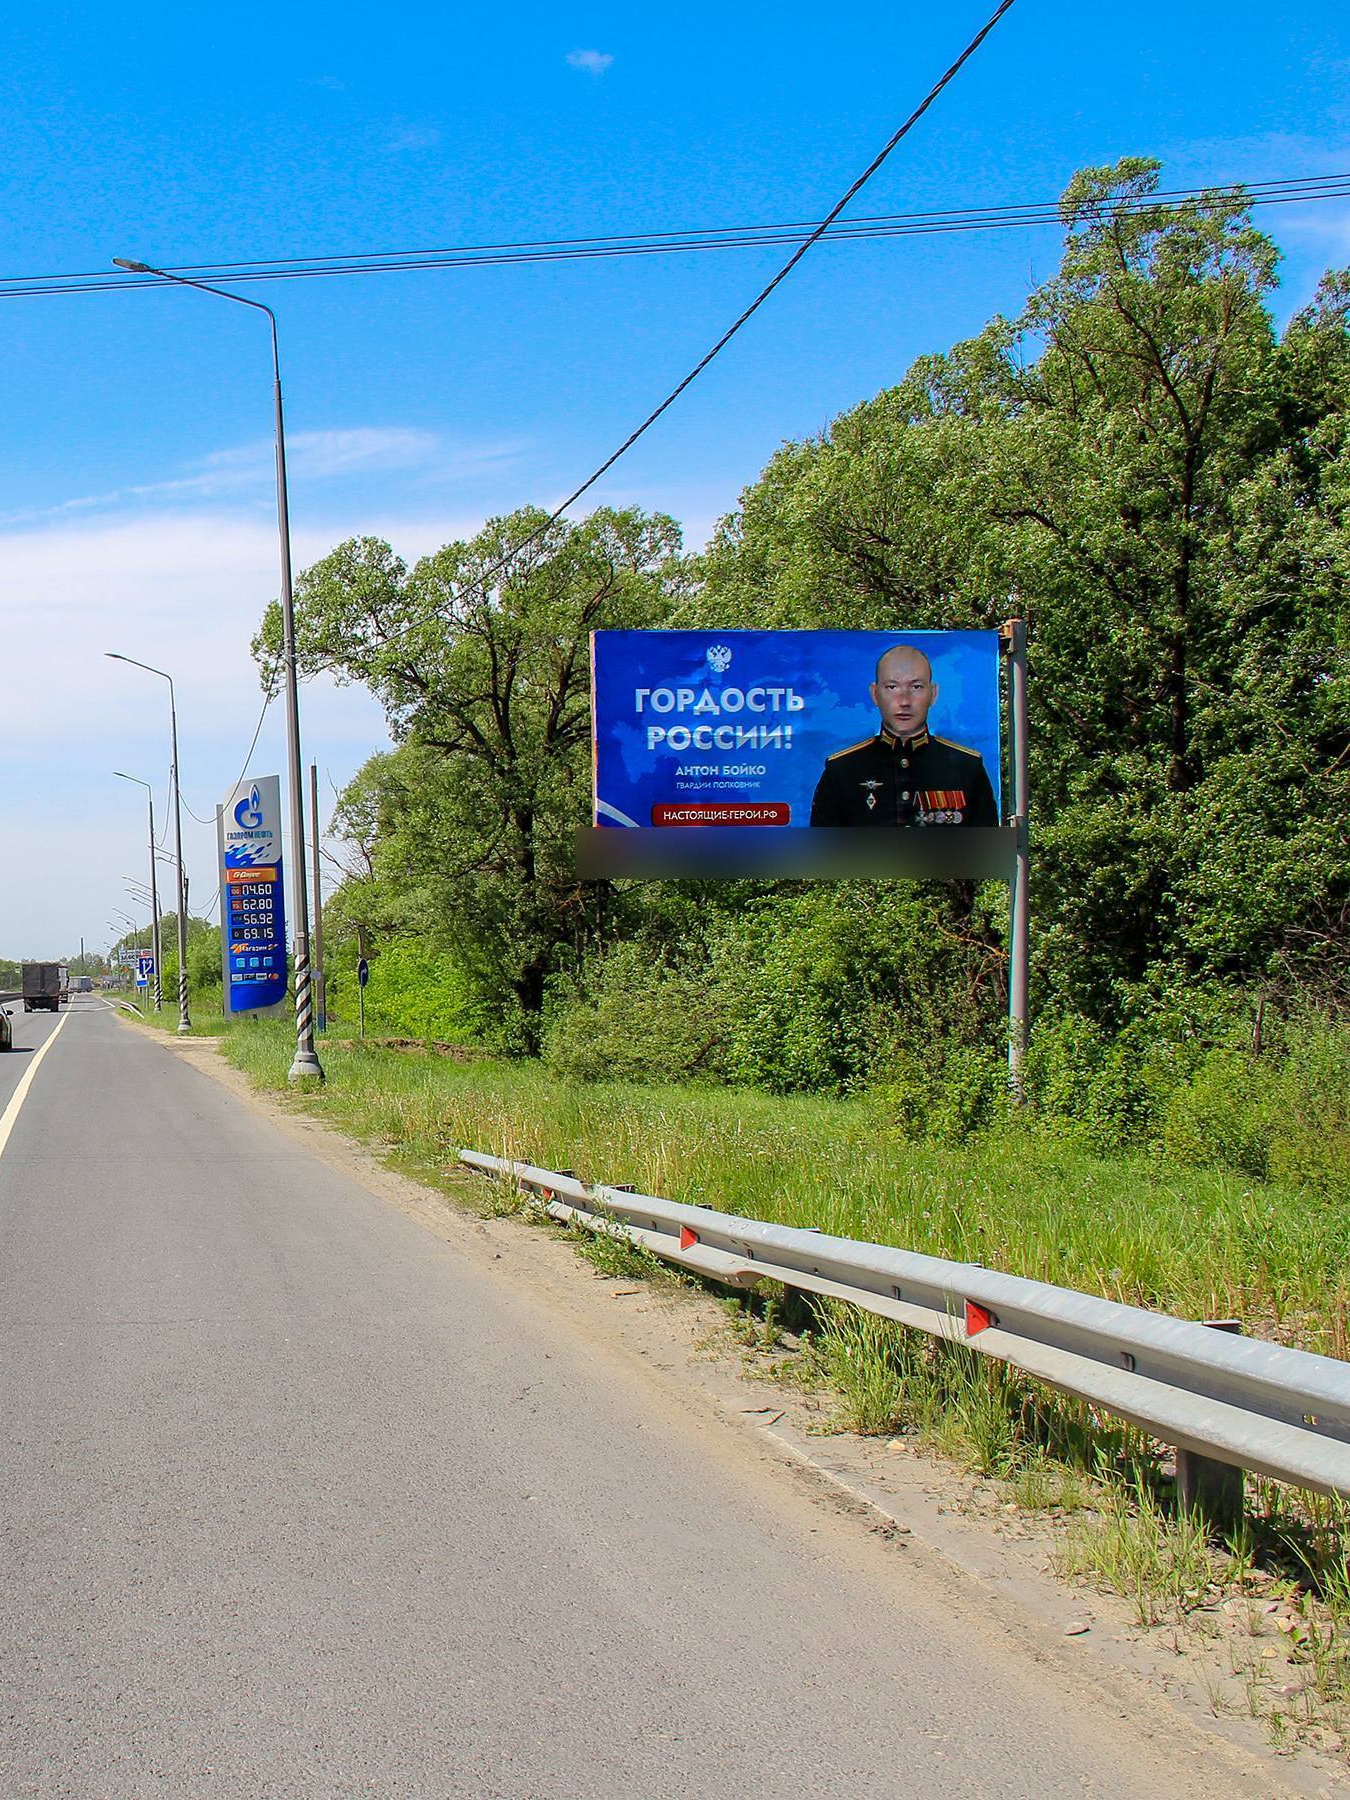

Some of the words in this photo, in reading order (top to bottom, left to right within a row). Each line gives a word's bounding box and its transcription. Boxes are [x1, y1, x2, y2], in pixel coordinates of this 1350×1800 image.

[635, 688, 805, 715] ГОРДОСТЬ
[647, 725, 792, 750] РОССИИ!
[675, 766, 719, 776] АНТОН
[722, 763, 766, 775] БОЙКО
[663, 810, 778, 820] НАСТОЯЩИЕ-ГЕРОИ.РФ
[226, 831, 273, 840] ГАЗПРОМНЕФТЬ
[242, 899, 273, 910] 62.80
[243, 913, 273, 924] 56.92
[244, 928, 274, 939] 69.15
